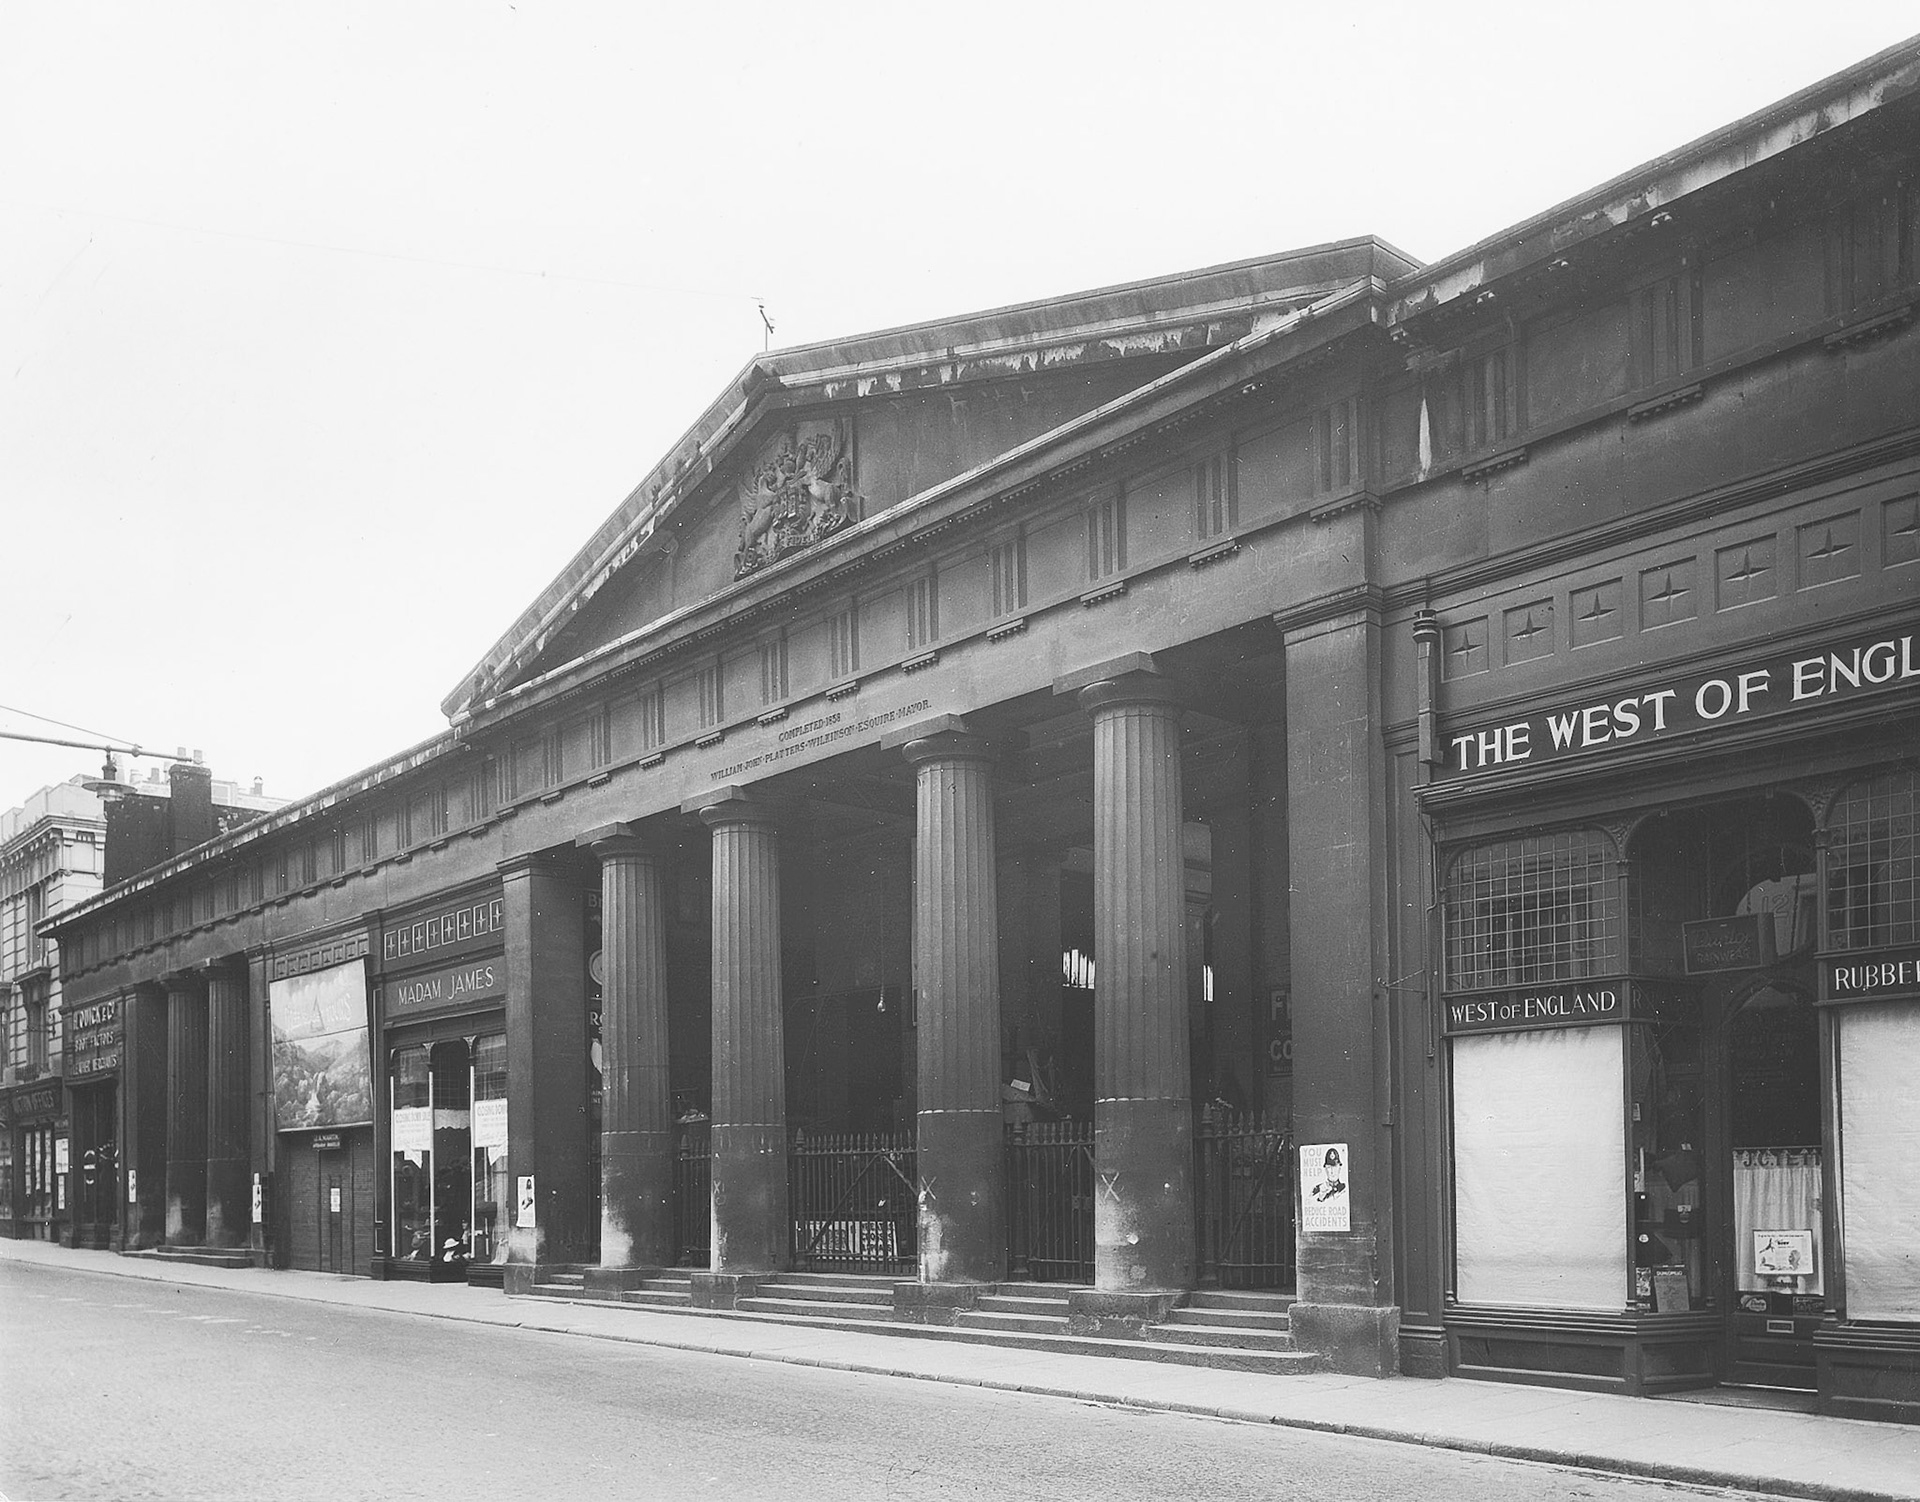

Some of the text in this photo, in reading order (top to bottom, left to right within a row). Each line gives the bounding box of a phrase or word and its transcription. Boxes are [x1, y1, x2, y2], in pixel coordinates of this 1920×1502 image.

[1451, 635, 1920, 771] THE WEST OF ENGL
[1835, 960, 1920, 991] RUBBE
[398, 965, 494, 1006] MADAM JAMES
[1450, 1001, 1499, 1025] WEST
[1499, 1003, 1522, 1020] OF
[1523, 990, 1616, 1019] ENGLAND
[1302, 1147, 1322, 1157] YOU
[1303, 1157, 1322, 1167] MUST
[1303, 1167, 1323, 1177] HELP
[1304, 1206, 1347, 1216] REDUCE ROAD
[1305, 1216, 1347, 1228] ACCIDENTS
